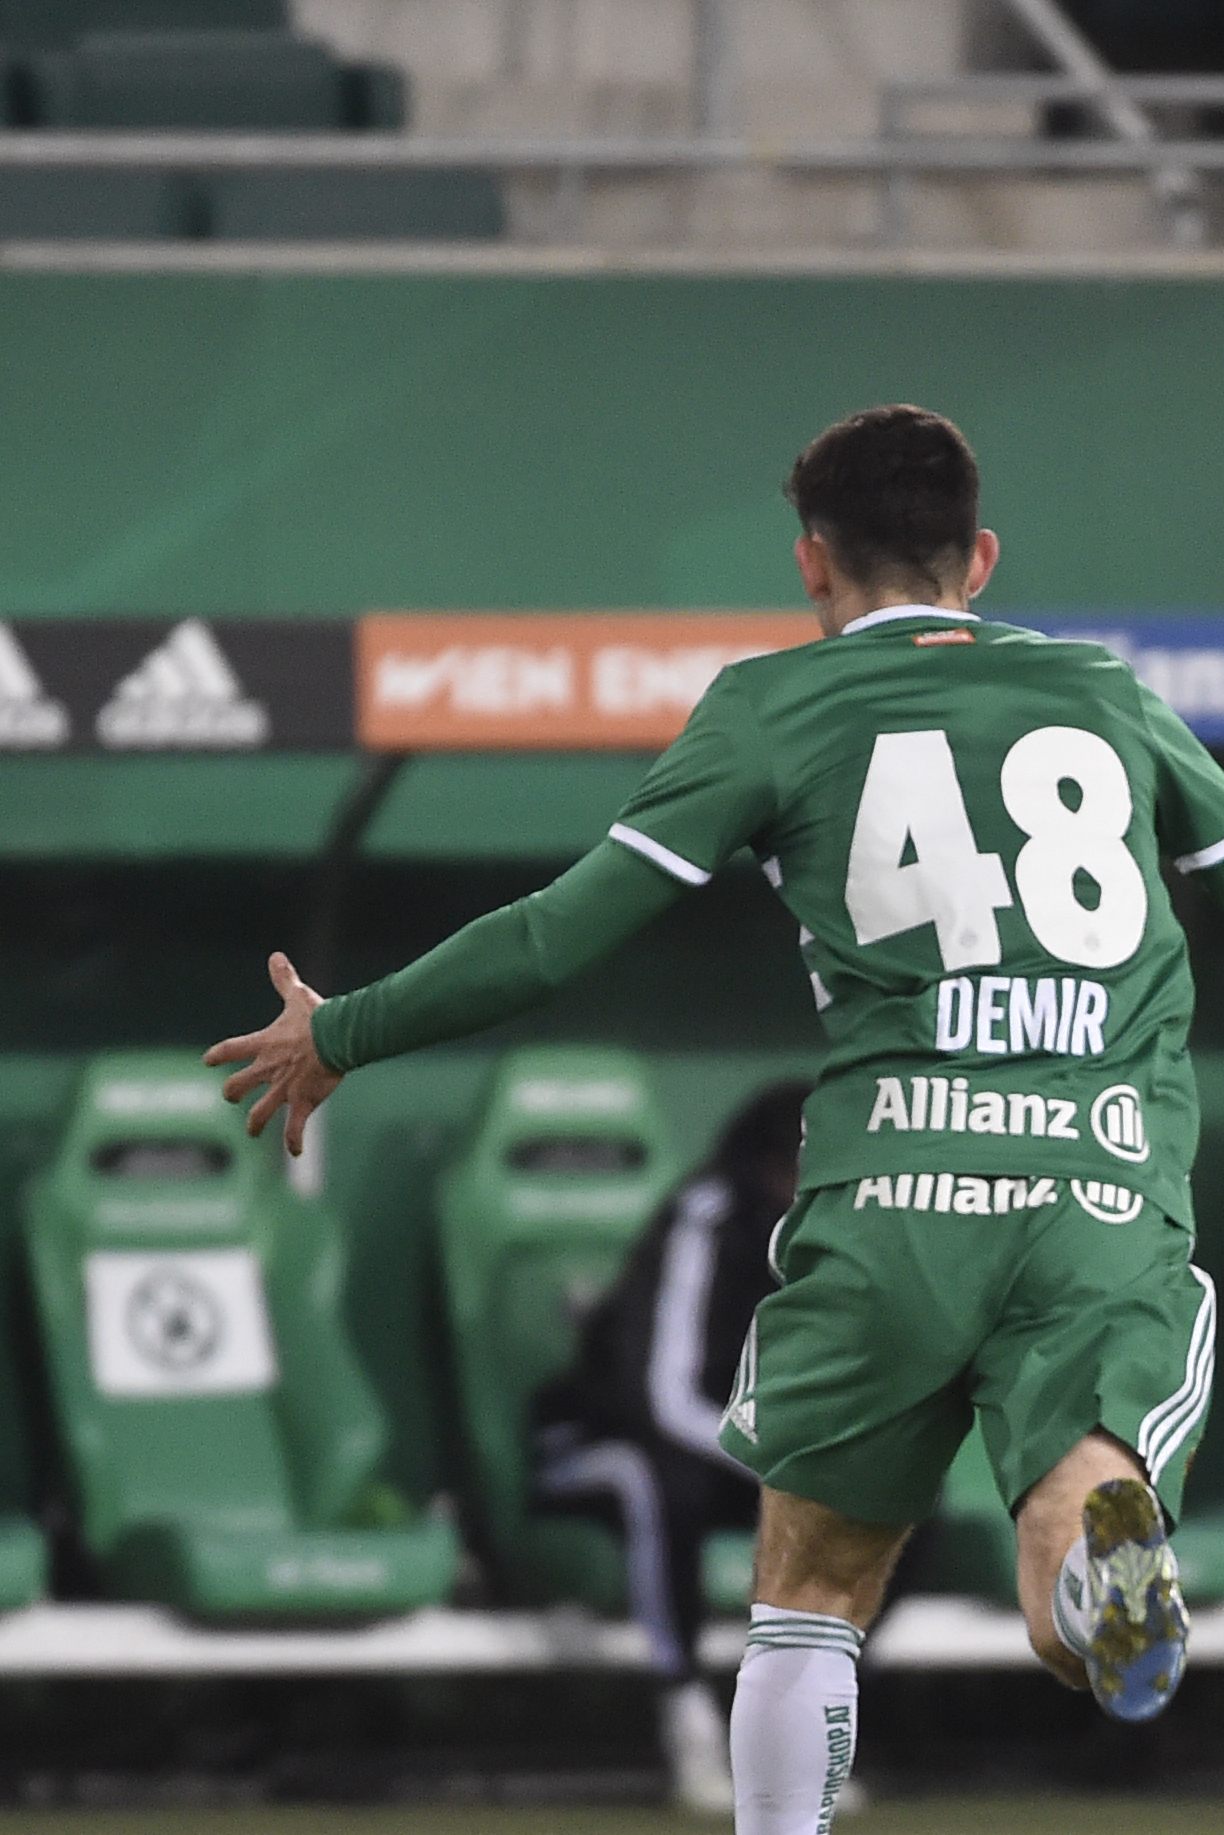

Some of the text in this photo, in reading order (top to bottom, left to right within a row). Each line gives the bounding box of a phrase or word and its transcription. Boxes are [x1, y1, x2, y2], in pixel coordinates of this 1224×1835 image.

[844, 725, 1149, 973] 48
[935, 976, 1109, 1057] DEMIR
[866, 1076, 1080, 1140] Allianz
